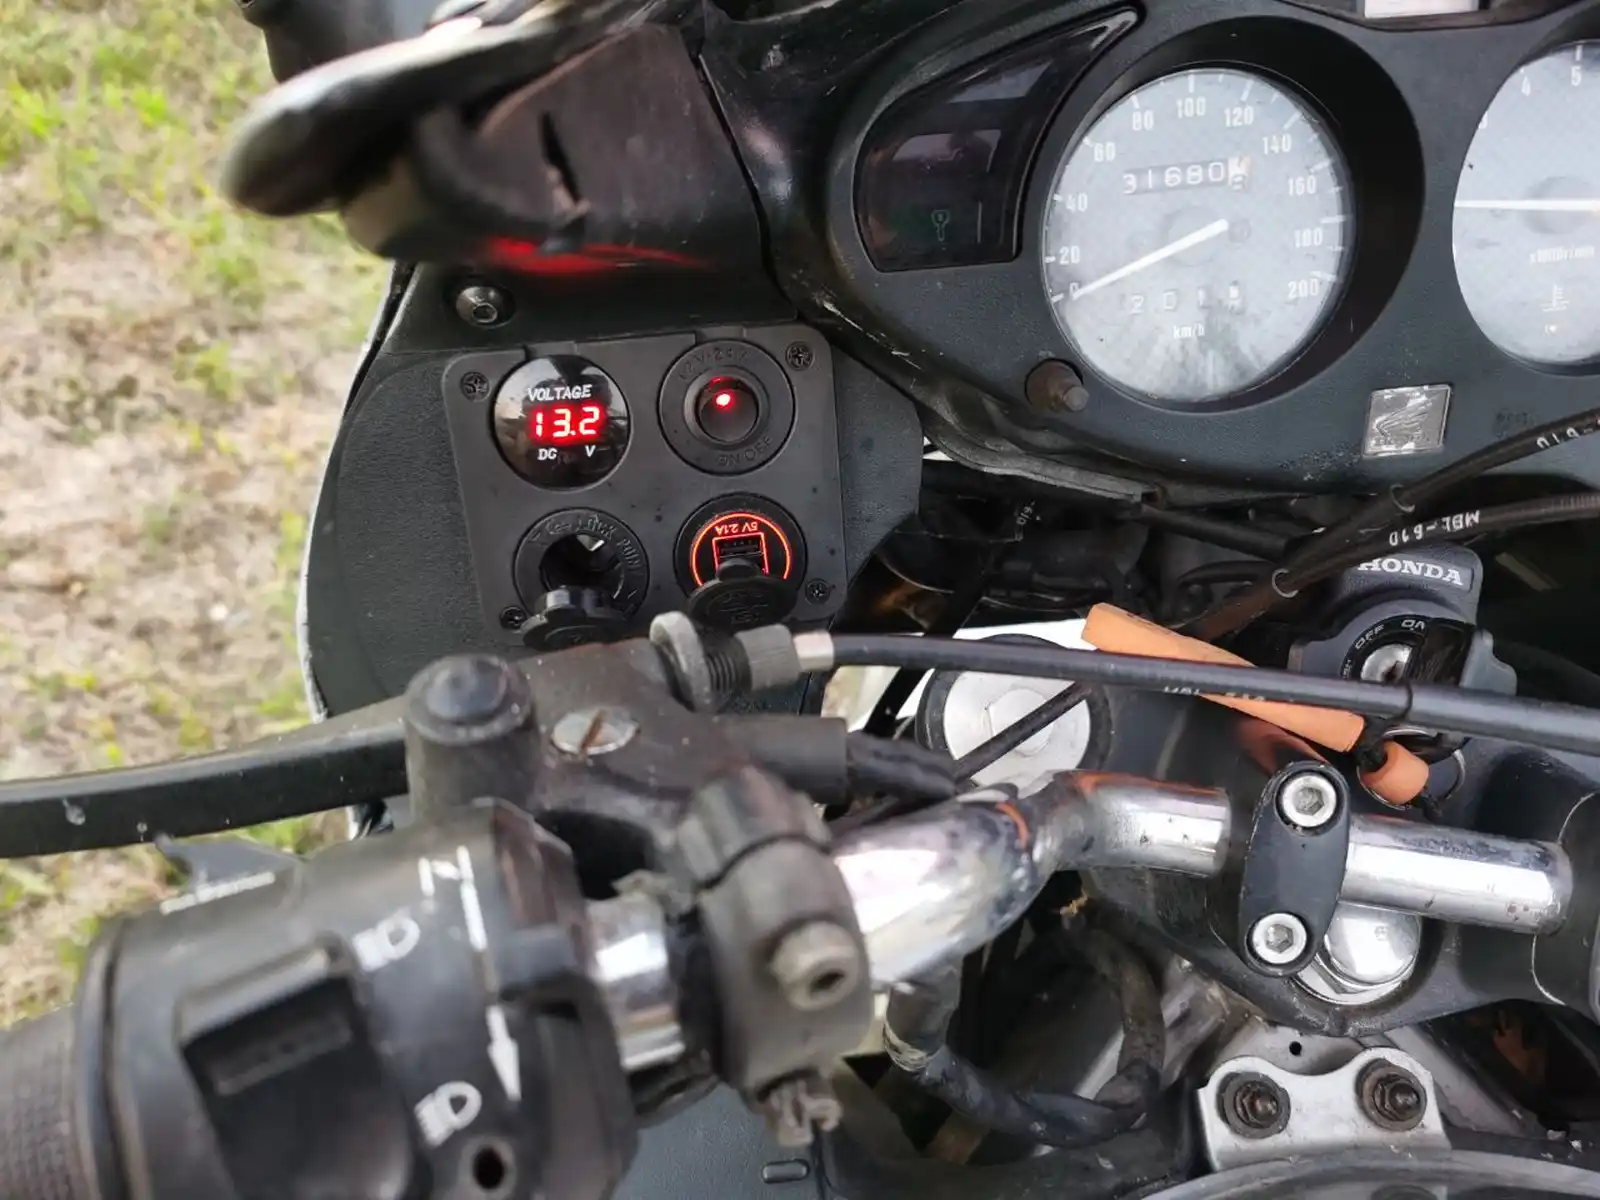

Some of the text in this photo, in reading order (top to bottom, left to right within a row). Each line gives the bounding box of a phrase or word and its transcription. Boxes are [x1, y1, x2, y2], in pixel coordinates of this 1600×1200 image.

[1570, 64, 1582, 87] 5
[1176, 97, 1206, 119] 100
[1224, 106, 1255, 127] 120
[1132, 110, 1154, 131] 80
[1094, 142, 1116, 162] 60
[1262, 134, 1292, 155] 140
[1288, 174, 1317, 195] 160
[1066, 193, 1088, 212] 40
[1294, 227, 1323, 248] 180
[1059, 246, 1081, 264] 20
[1288, 278, 1319, 299] 200
[1172, 322, 1205, 340] km/h
[527, 384, 593, 402] VOLTAGE
[535, 405, 601, 438] 13.2
[537, 444, 596, 461] DC V
[1357, 556, 1463, 586] HONDA
[1355, 624, 1385, 650] OFF
